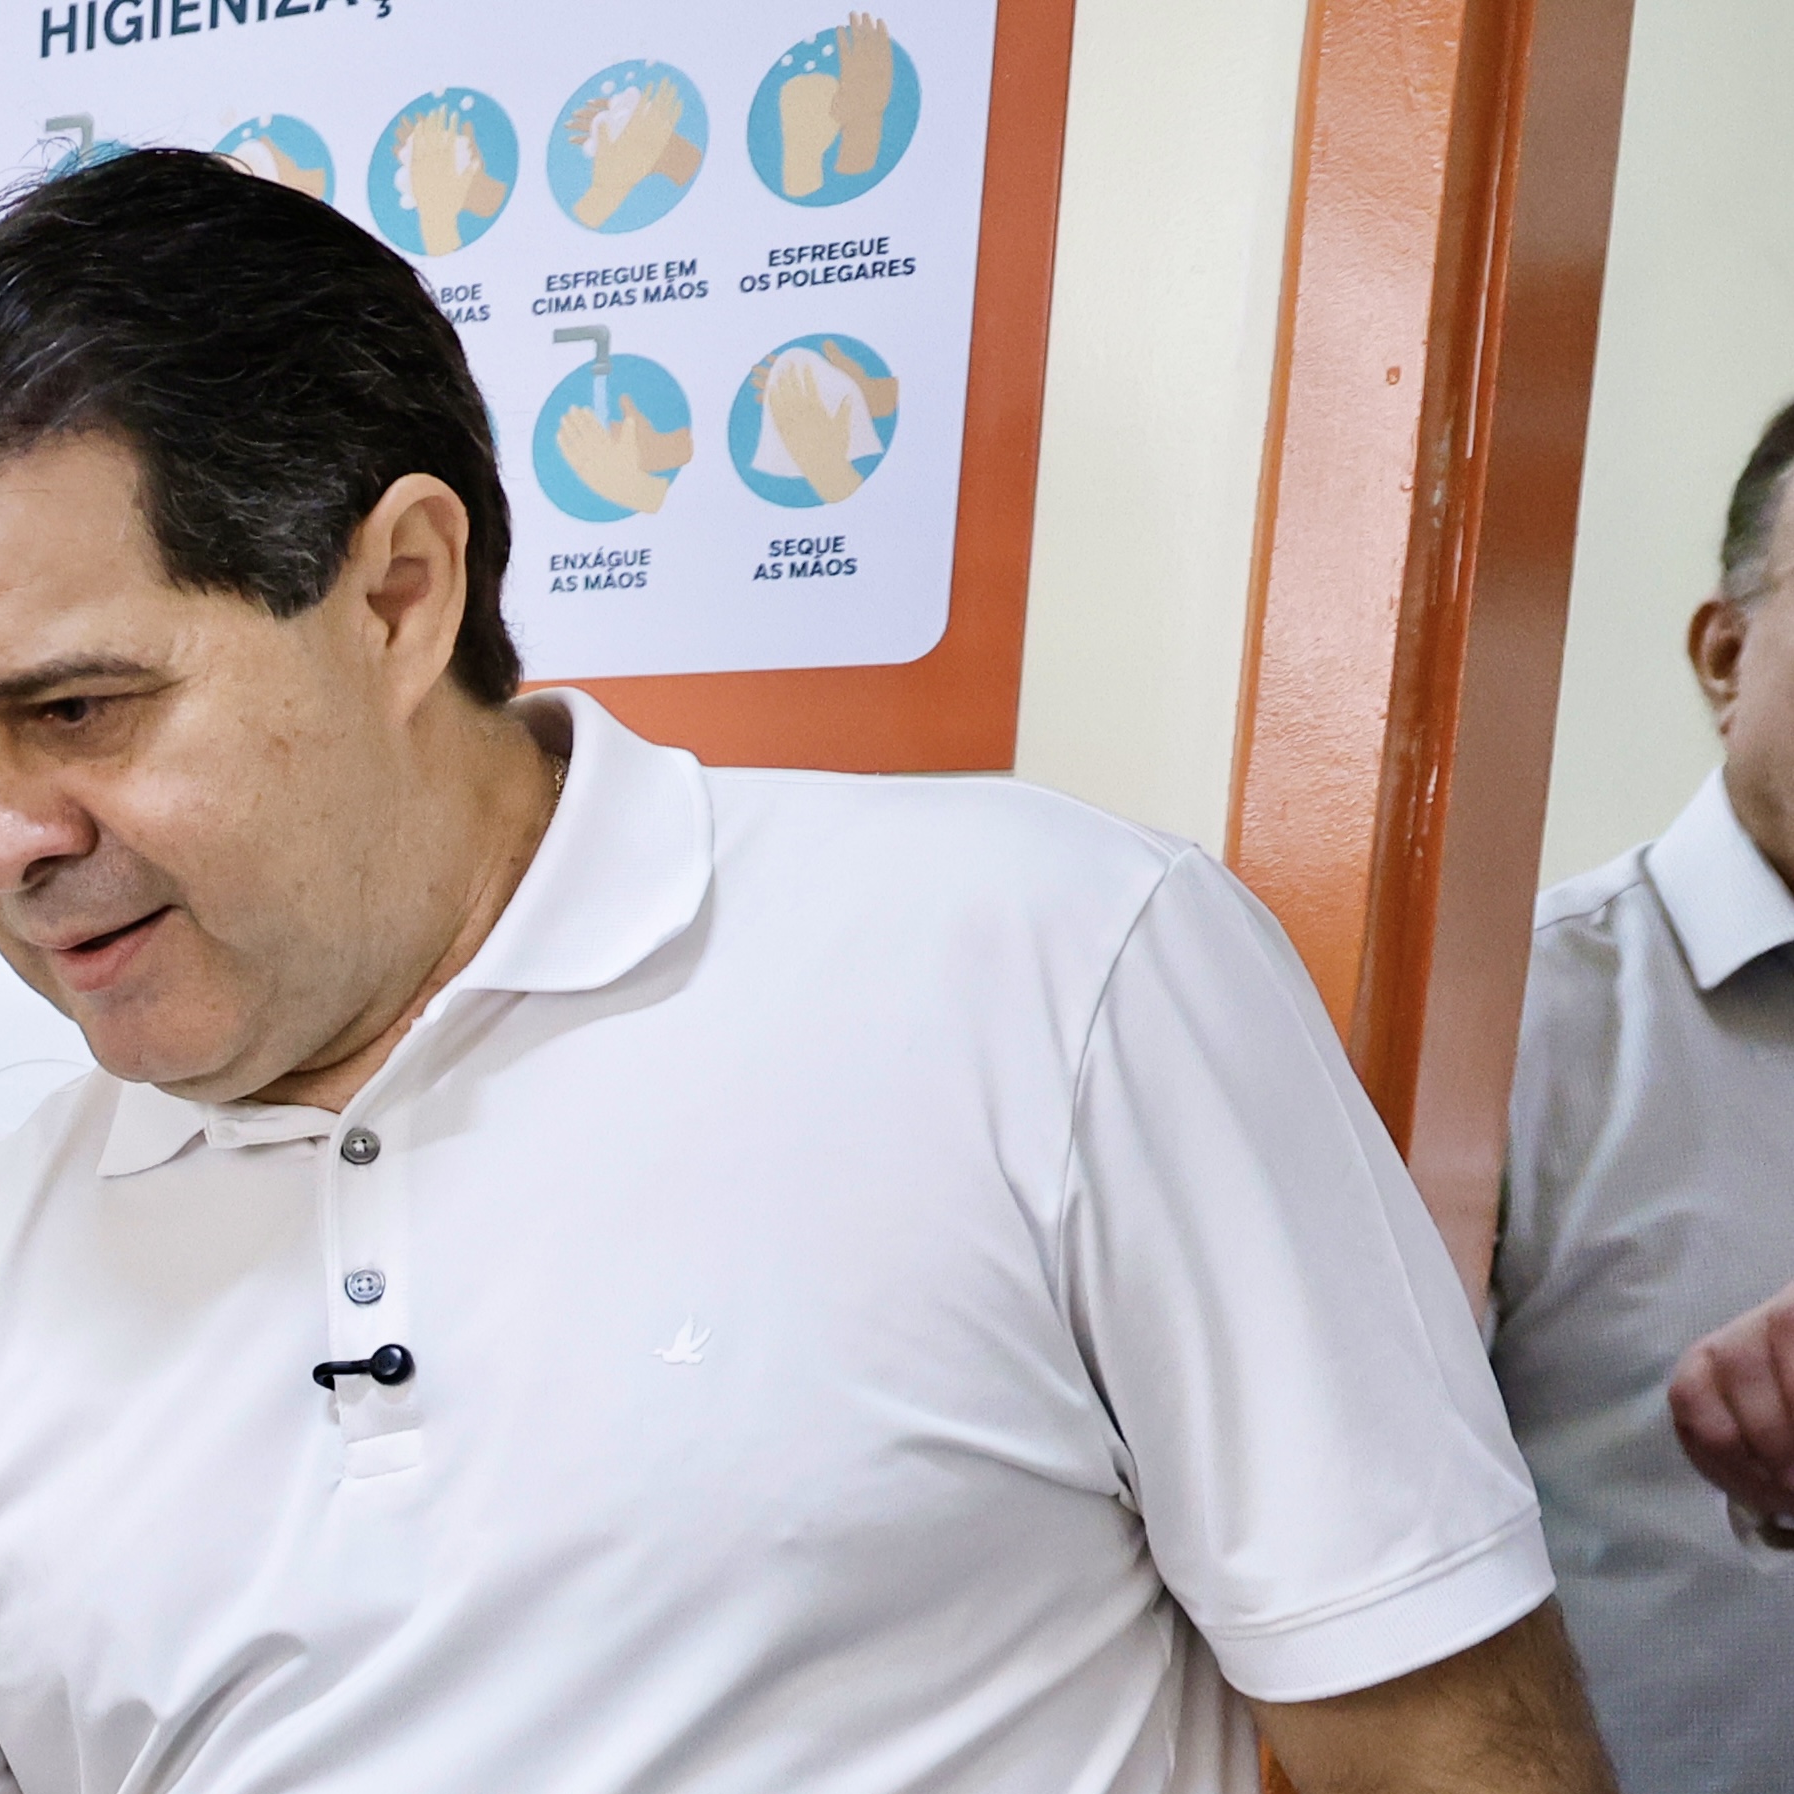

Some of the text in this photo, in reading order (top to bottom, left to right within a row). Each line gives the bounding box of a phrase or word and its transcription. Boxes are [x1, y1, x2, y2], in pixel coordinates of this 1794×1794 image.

[39, 0, 393, 59] HIGIEN
[768, 236, 890, 268] ESFREGUE
[545, 258, 698, 293] ESFREGUE EM
[739, 257, 917, 293] OS POLEGARES
[532, 279, 710, 316] CIMA DAS MÃOS
[549, 546, 652, 572] ENXÁGUE
[768, 535, 846, 558] SEQUE
[549, 575, 579, 594] AS
[752, 562, 784, 582] AS
